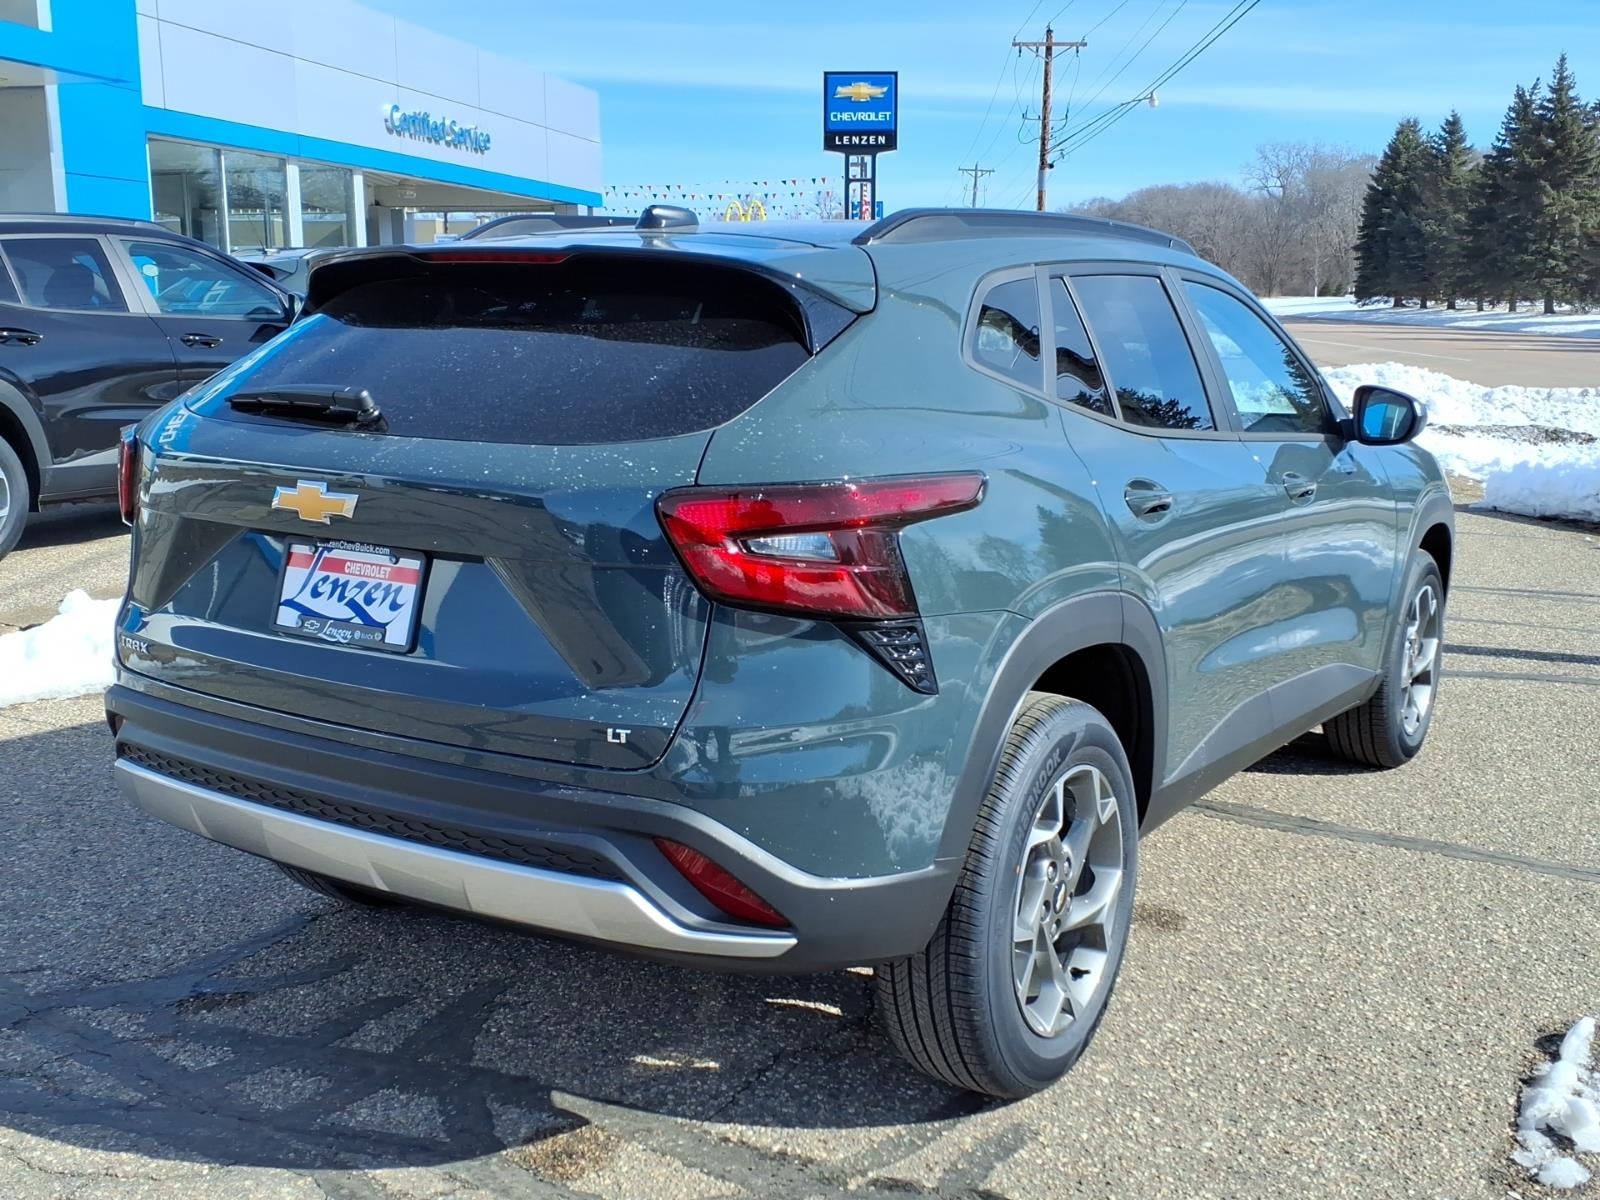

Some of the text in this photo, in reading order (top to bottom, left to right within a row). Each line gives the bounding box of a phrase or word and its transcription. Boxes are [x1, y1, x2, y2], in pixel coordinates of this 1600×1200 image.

[830, 111, 891, 121] CHEVROLET
[390, 104, 491, 151] Certified Service
[835, 135, 886, 145] LENZEN
[344, 561, 391, 578] CHEVROLET
[280, 547, 408, 628] Lenzen
[317, 619, 353, 643] Lenzen
[121, 635, 149, 655] TRAX
[607, 728, 631, 743] LT
